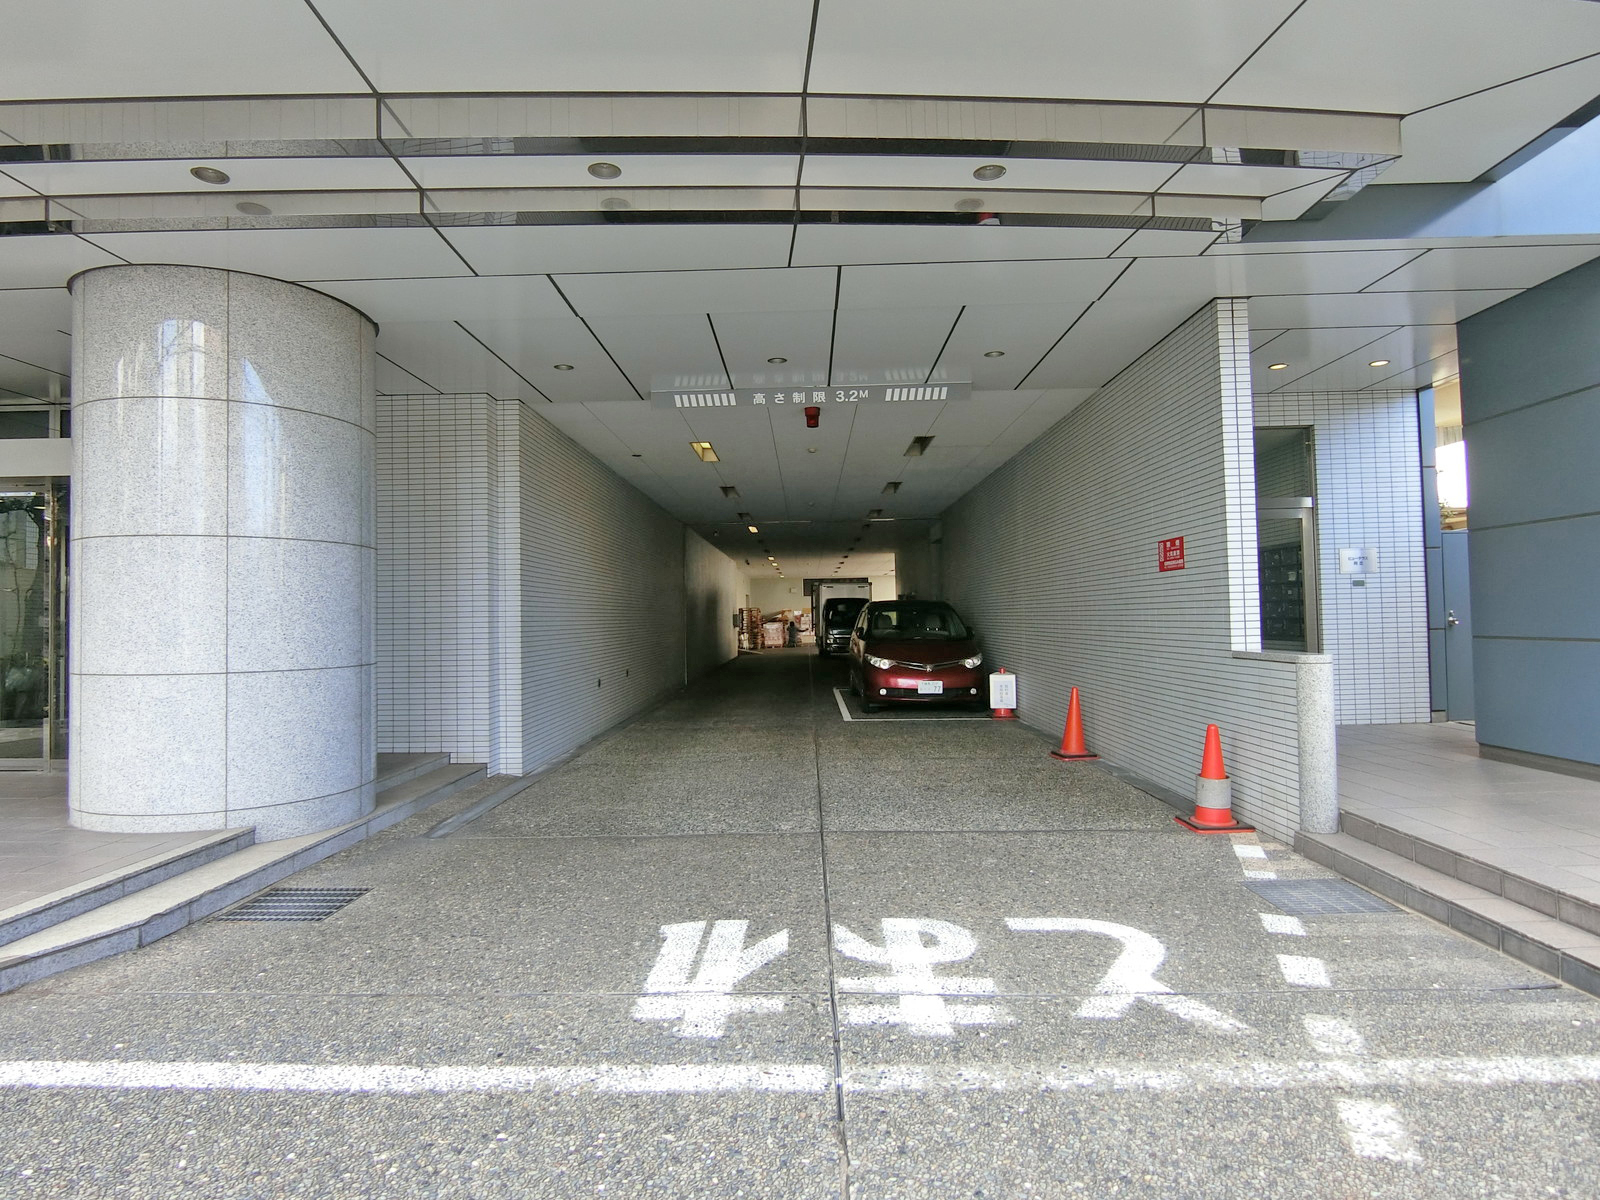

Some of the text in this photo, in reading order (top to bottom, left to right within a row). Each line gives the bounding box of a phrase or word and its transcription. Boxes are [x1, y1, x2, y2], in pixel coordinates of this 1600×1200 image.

[753, 389, 869, 405] 高さ制限 3.2M
